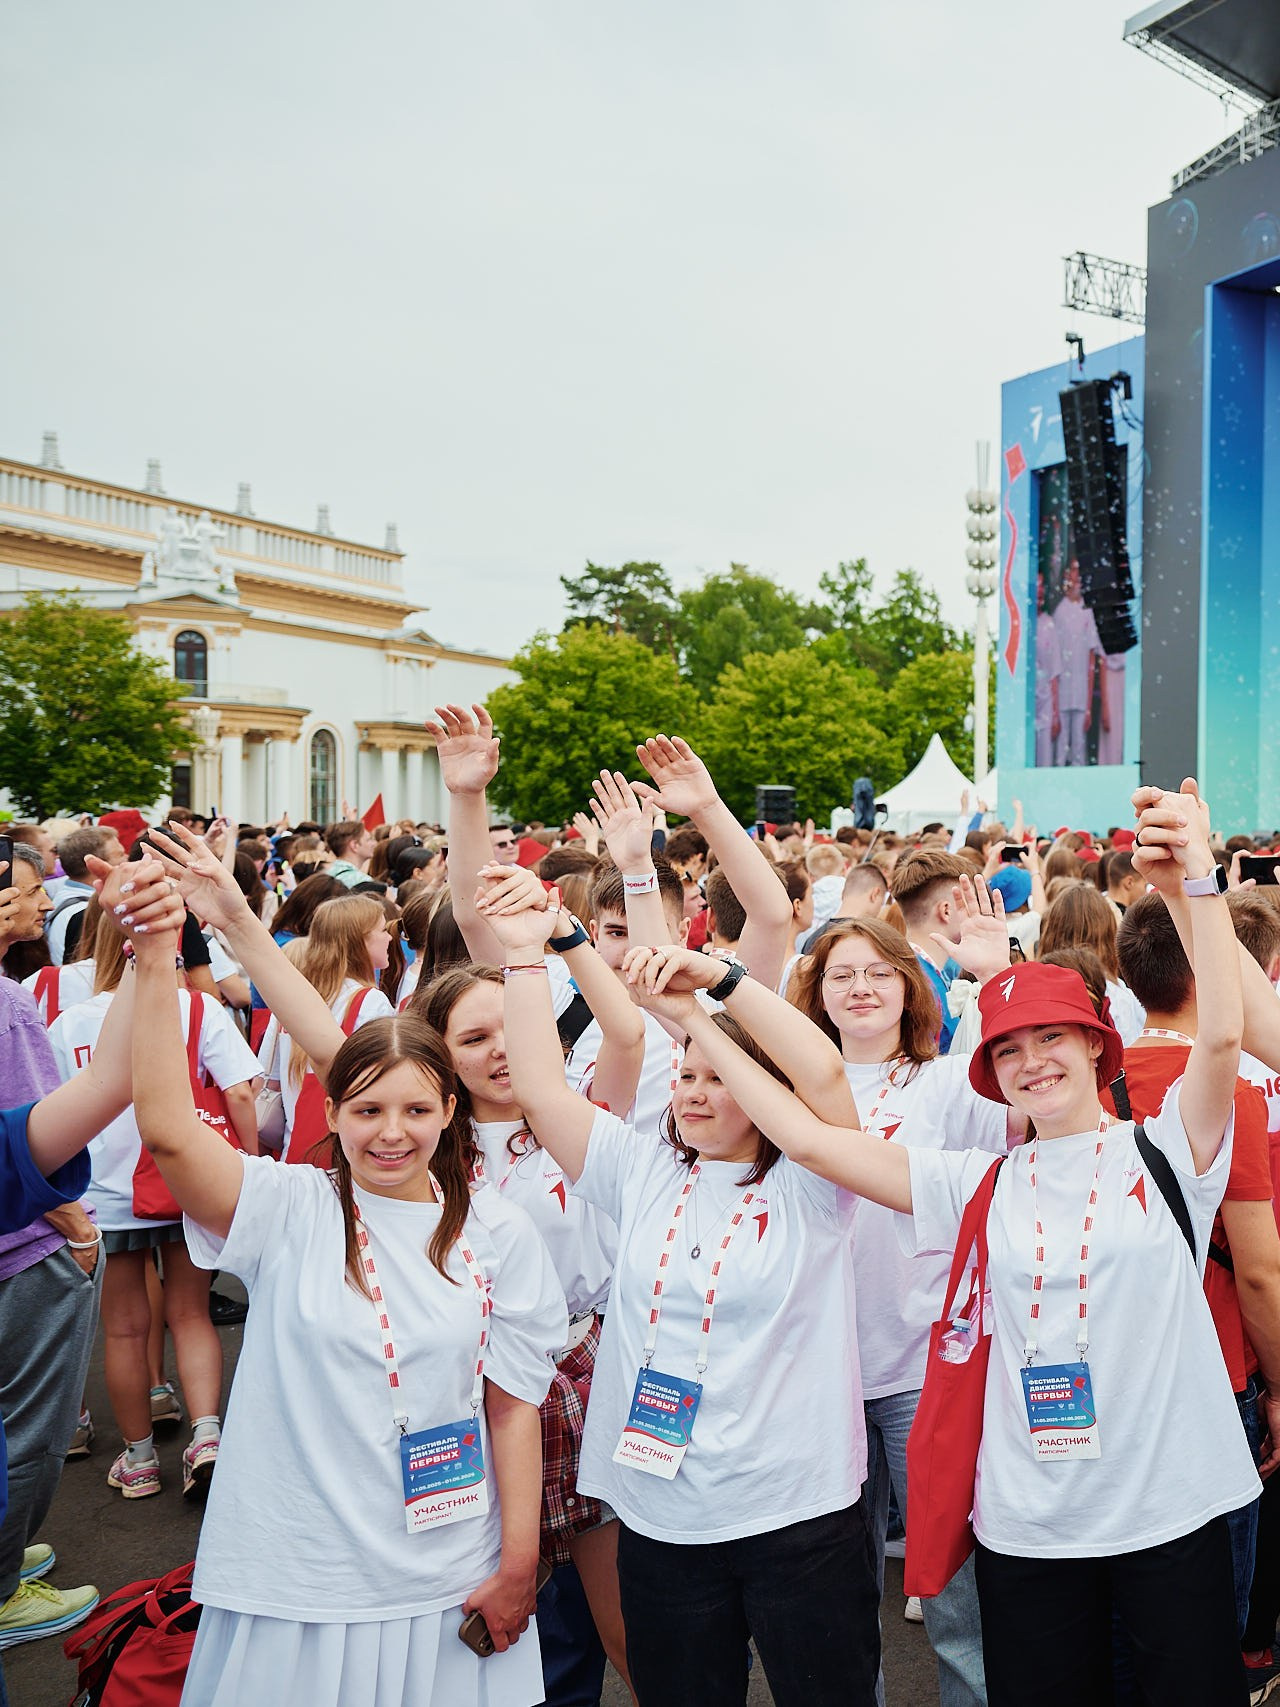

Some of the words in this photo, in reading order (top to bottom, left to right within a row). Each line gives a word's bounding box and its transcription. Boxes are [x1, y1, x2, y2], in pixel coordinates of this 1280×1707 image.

[642, 1381, 680, 1396] ФЕСТИВАЛЬ
[1028, 1377, 1070, 1385] ФЕСТИВАЛЬ
[1030, 1383, 1071, 1392] ДВИЖЕНИЯ
[638, 1395, 678, 1412] ПЕРВЫХ
[640, 1388, 680, 1403] ДВИЖЕНИЯ
[1030, 1391, 1072, 1400] ПЕРВЫХ
[409, 1436, 458, 1453] ФЕСТИВАЛЬ
[1037, 1436, 1091, 1446] УЧАСТНИК
[409, 1442, 459, 1460] ДВИЖЕНИЯ
[623, 1440, 675, 1462] УЧАСТНИК
[410, 1450, 459, 1469] ПЕРВЫХ
[414, 1494, 479, 1517] УЧАСТНИК
